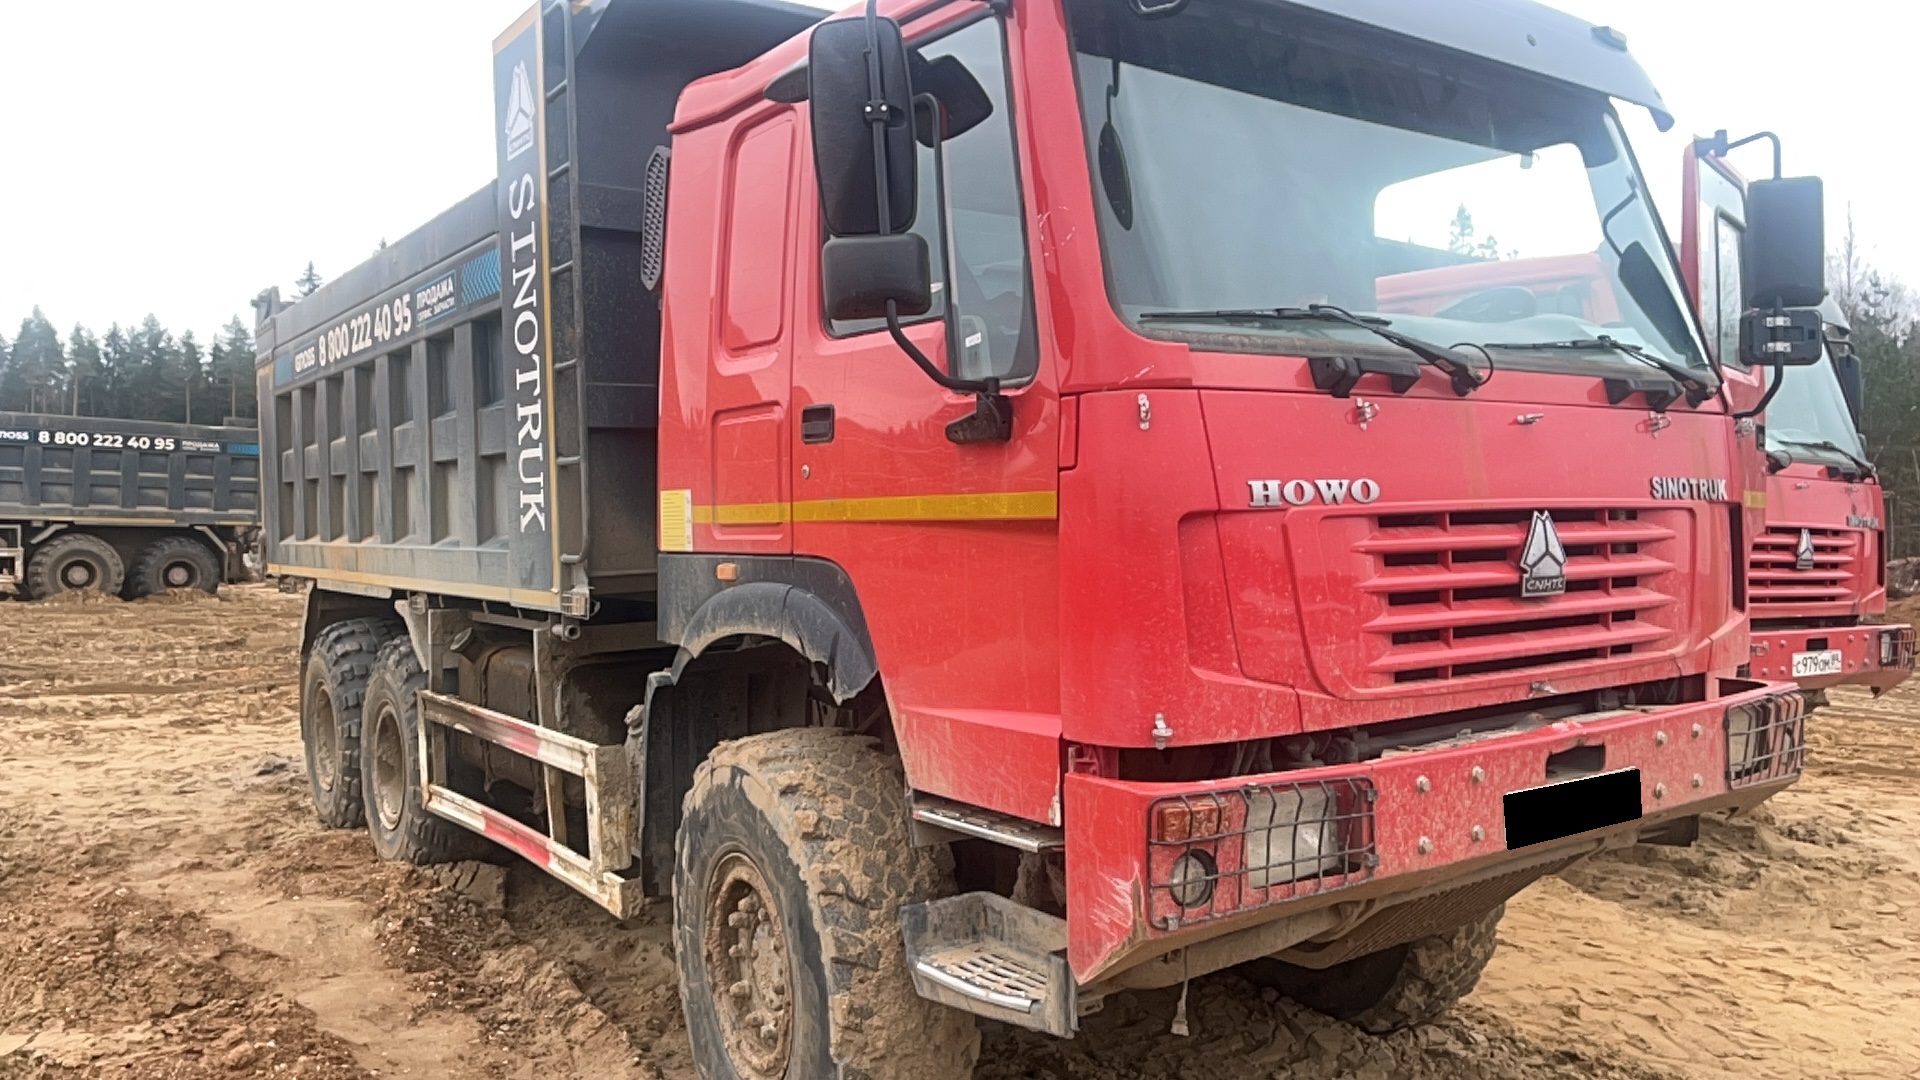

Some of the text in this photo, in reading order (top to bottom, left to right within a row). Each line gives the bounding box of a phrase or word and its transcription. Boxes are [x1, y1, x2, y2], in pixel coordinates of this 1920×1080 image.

[319, 335, 327, 367] 8
[327, 323, 349, 363] 800
[350, 312, 372, 353] 222
[374, 304, 391, 342] 40
[393, 293, 412, 336] 95
[509, 172, 546, 533] SINOTRUK
[38, 430, 50, 444] 8
[54, 431, 89, 446] 800
[93, 433, 123, 448] 222
[127, 436, 151, 450] 40
[154, 438, 175, 451] 95
[1247, 478, 1380, 507] HOWO
[1650, 475, 1728, 501] SINOTRUK
